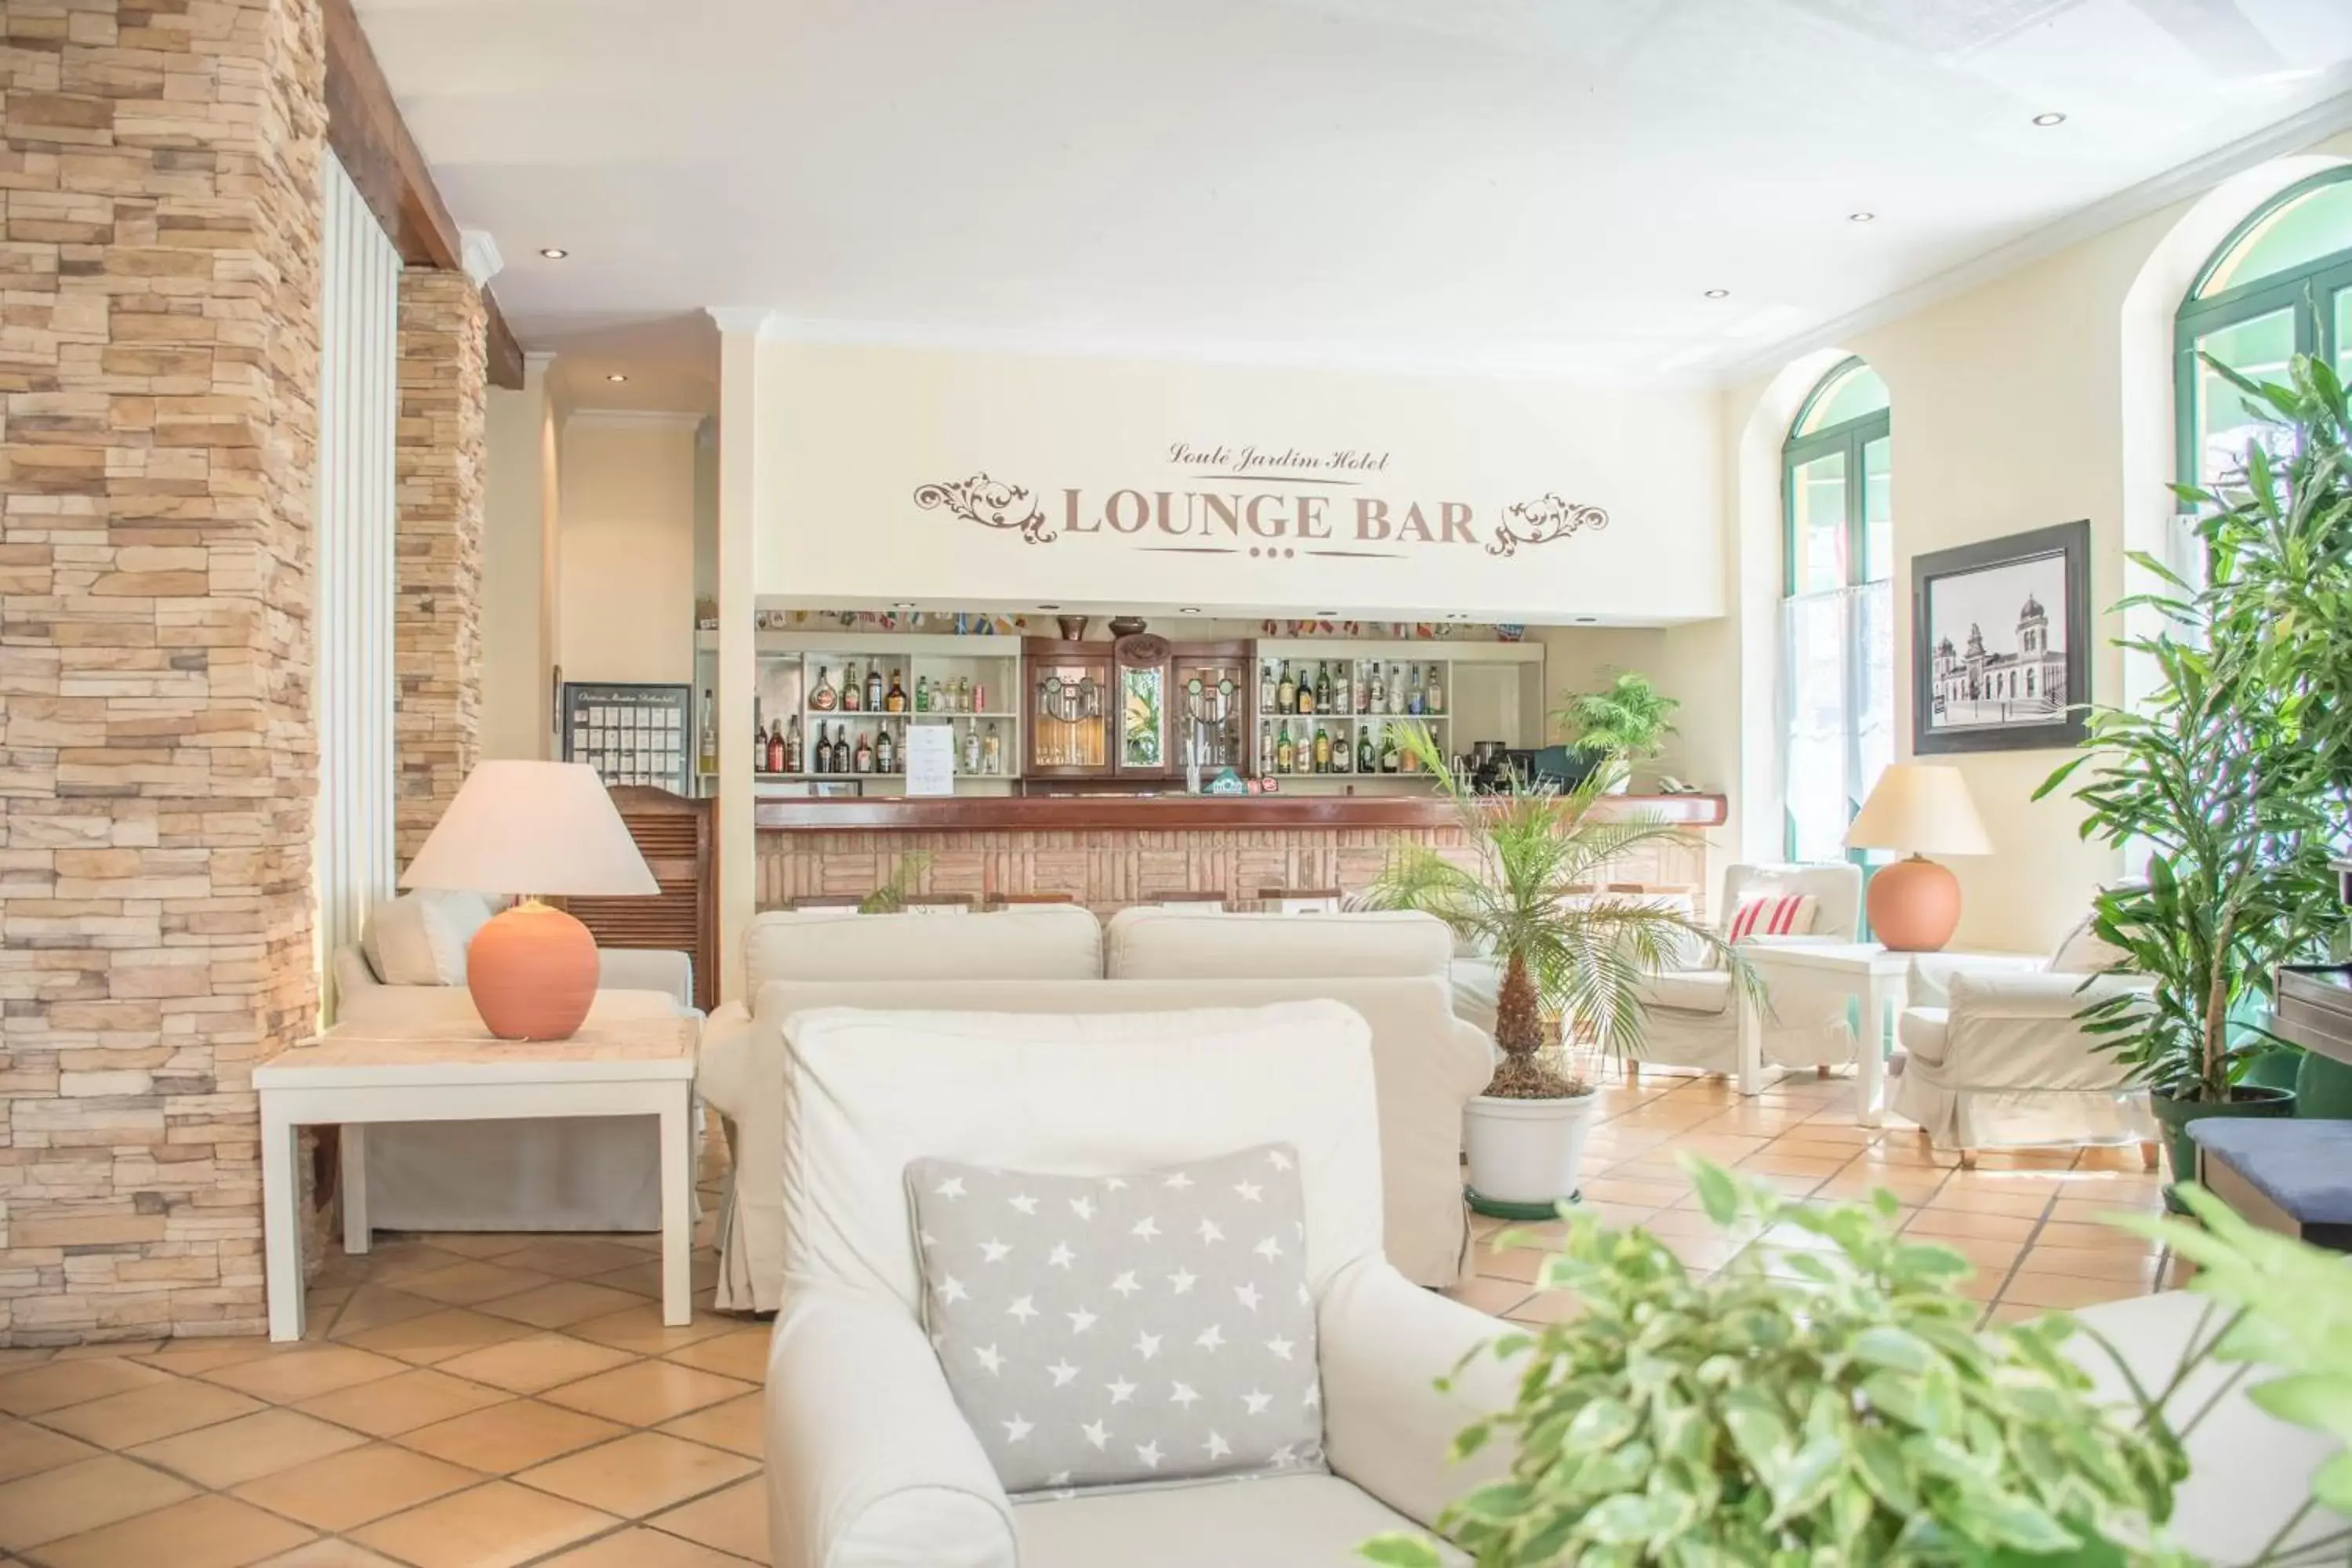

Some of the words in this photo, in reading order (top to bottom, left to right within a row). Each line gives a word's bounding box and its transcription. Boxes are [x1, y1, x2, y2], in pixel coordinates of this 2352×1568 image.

[1325, 449, 1390, 472] Hotel
[1062, 488, 1333, 539] LOUNGE
[1352, 497, 1482, 544] BAR
